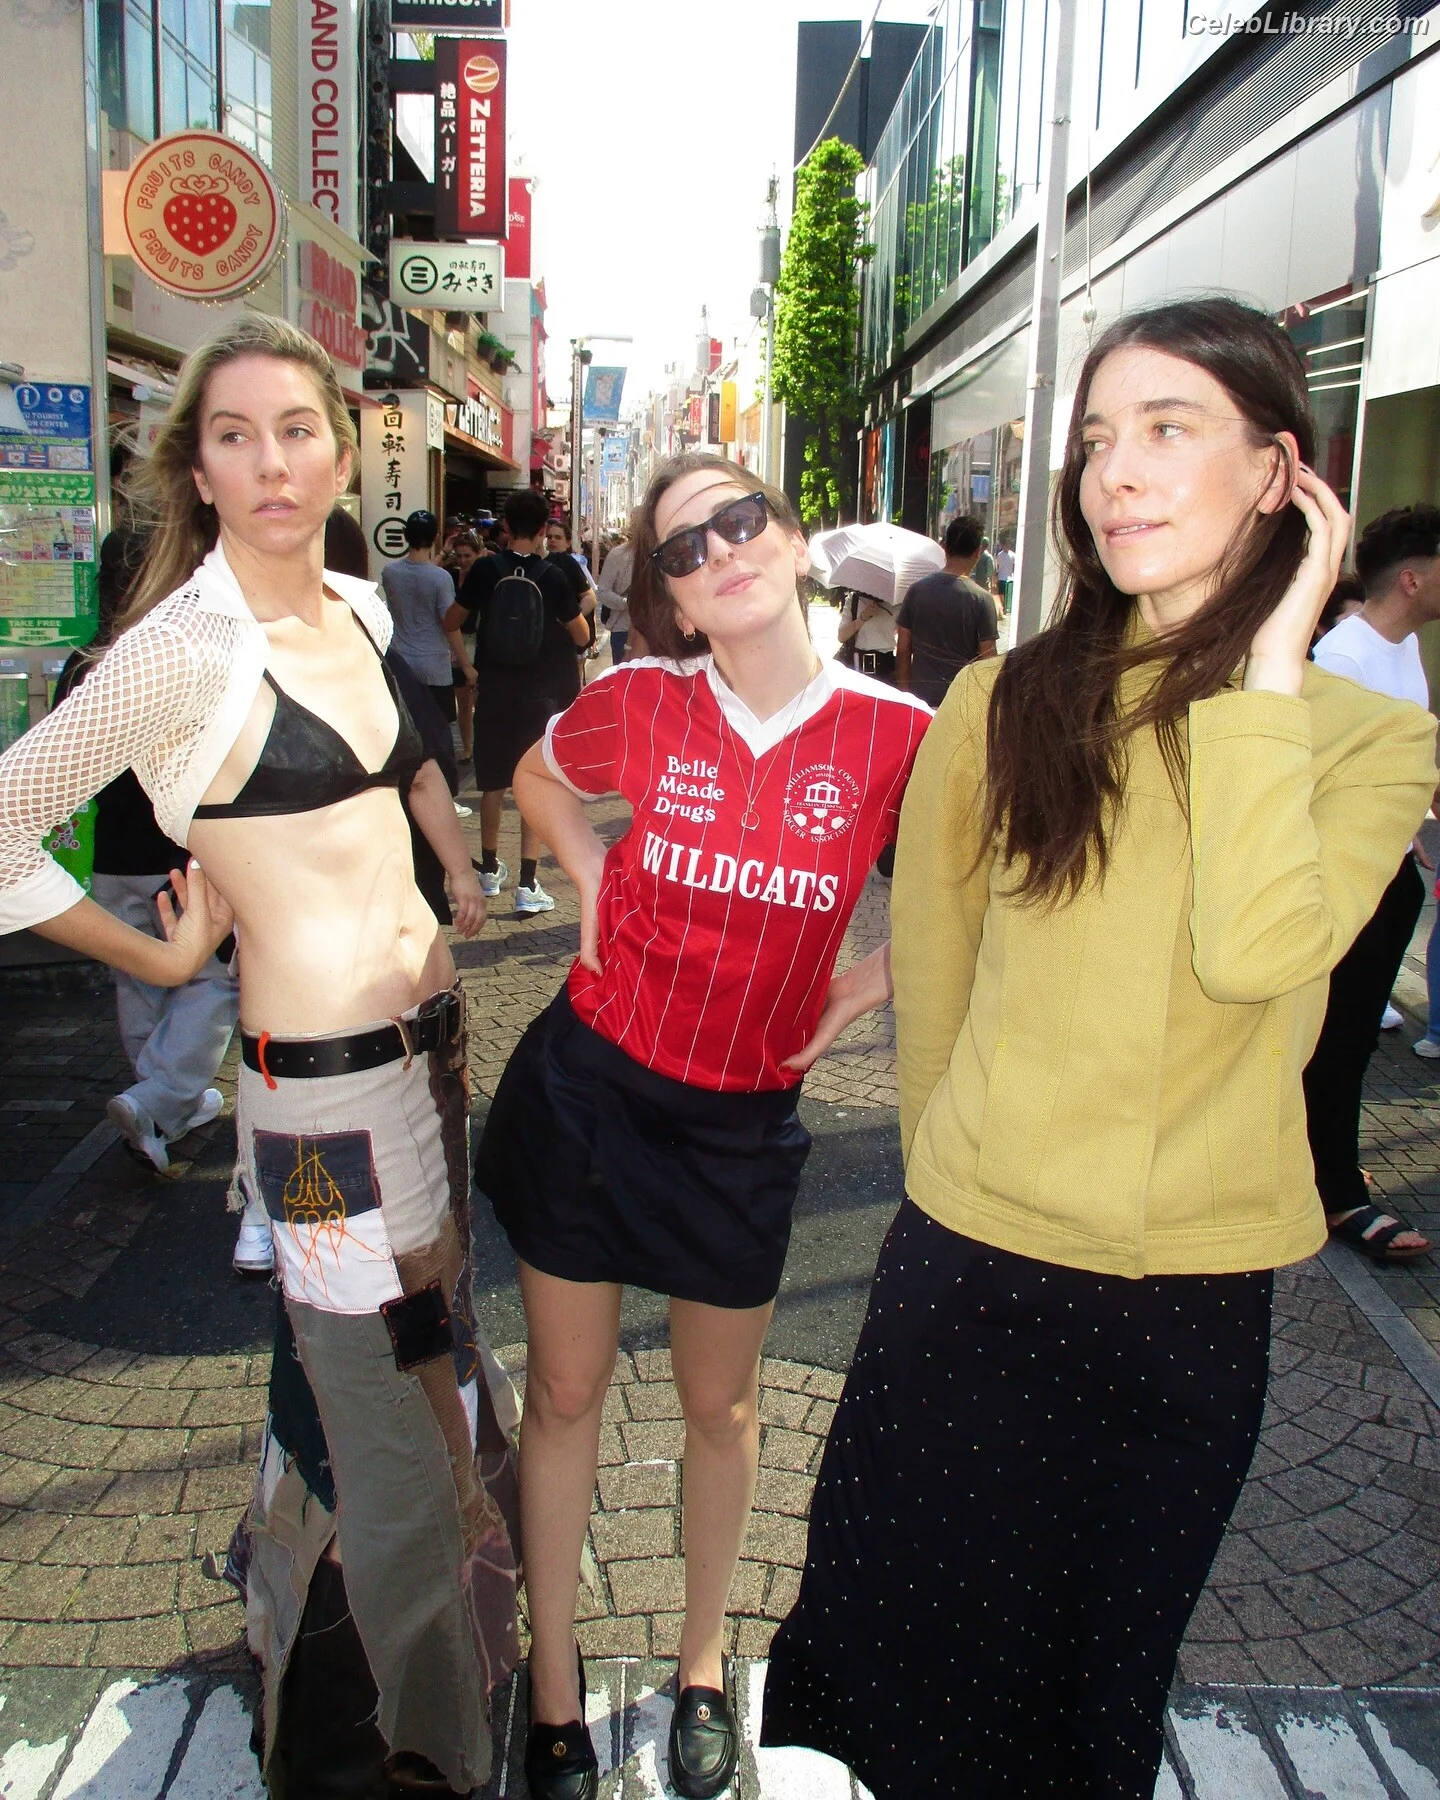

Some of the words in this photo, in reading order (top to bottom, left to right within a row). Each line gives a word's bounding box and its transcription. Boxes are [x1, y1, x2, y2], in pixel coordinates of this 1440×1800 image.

[440, 82, 456, 190] 絶品バーガー
[469, 98, 491, 218] ZETTERIA
[136, 151, 196, 210] FRUITS
[208, 153, 261, 206] CANDY
[139, 228, 205, 281] FRUITS
[215, 224, 263, 276] CANDY
[442, 271, 493, 294] みさき
[32, 412, 64, 420] TOURIST
[40, 420, 69, 428] CENTER
[381, 411, 406, 511] 回転寿司
[666, 755, 718, 779] Belle
[785, 763, 836, 791] WILLIAMSON
[838, 768, 860, 796] COUNTY
[656, 775, 726, 801] Meade
[653, 796, 717, 823] Drugs
[783, 809, 806, 839] SOCCER
[811, 814, 856, 843] ASSOCIATION
[641, 830, 840, 913] WILDCATS
